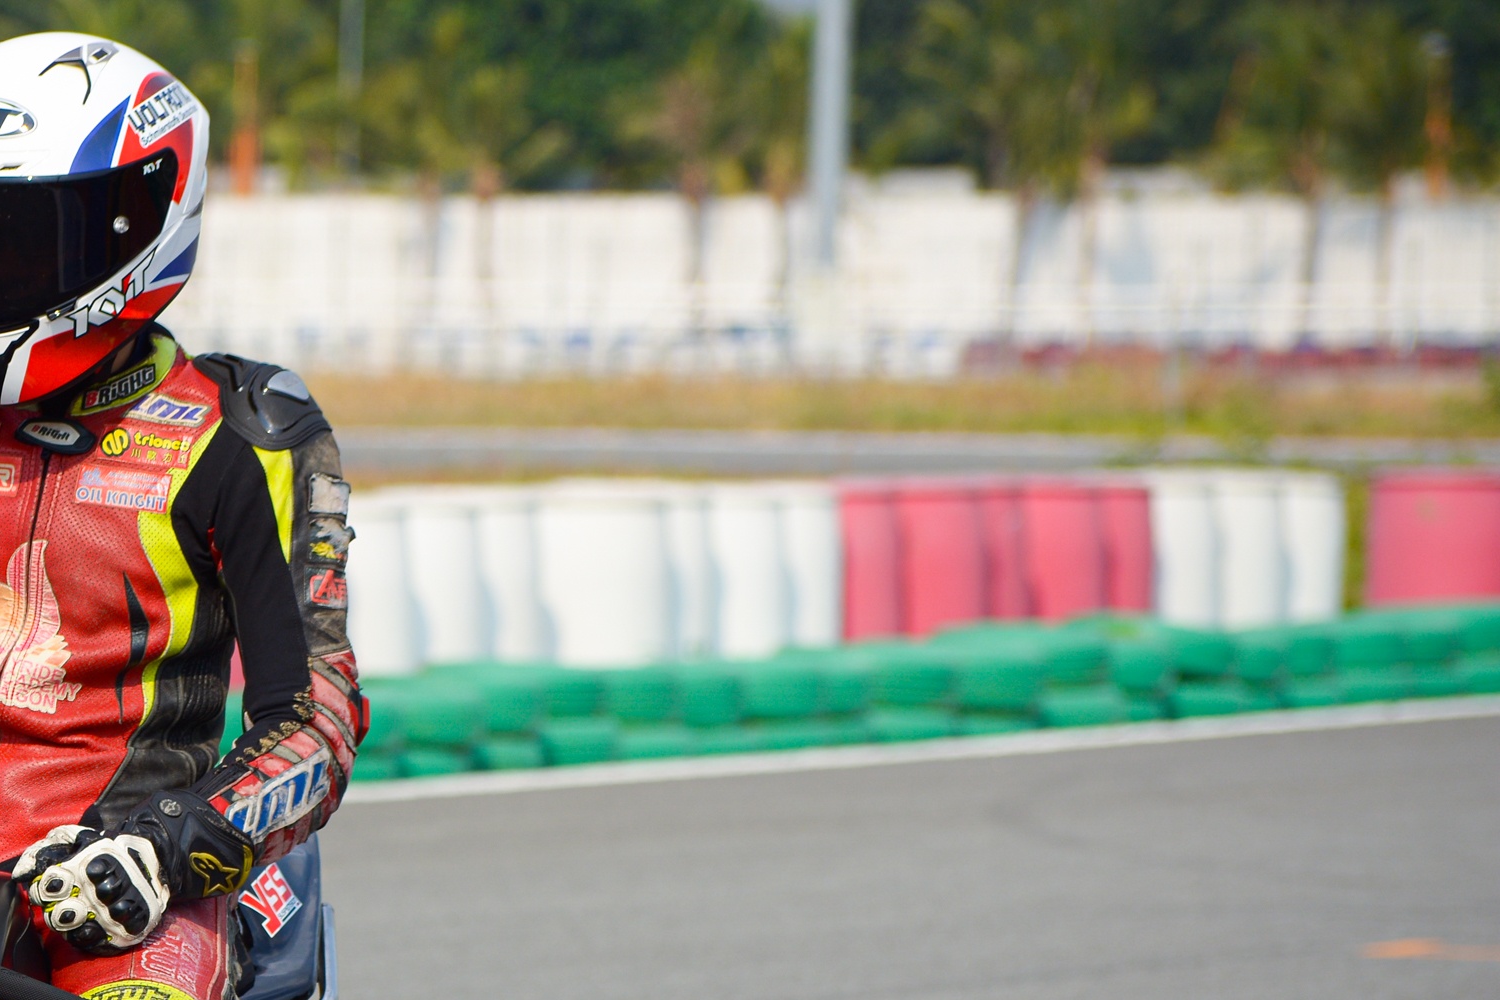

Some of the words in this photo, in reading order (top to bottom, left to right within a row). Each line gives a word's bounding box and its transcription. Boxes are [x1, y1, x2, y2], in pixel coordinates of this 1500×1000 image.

[143, 158, 163, 175] KYT
[64, 246, 158, 338] KYT
[133, 430, 191, 452] trionco
[76, 487, 101, 502] OIL
[240, 863, 293, 936] YSS
